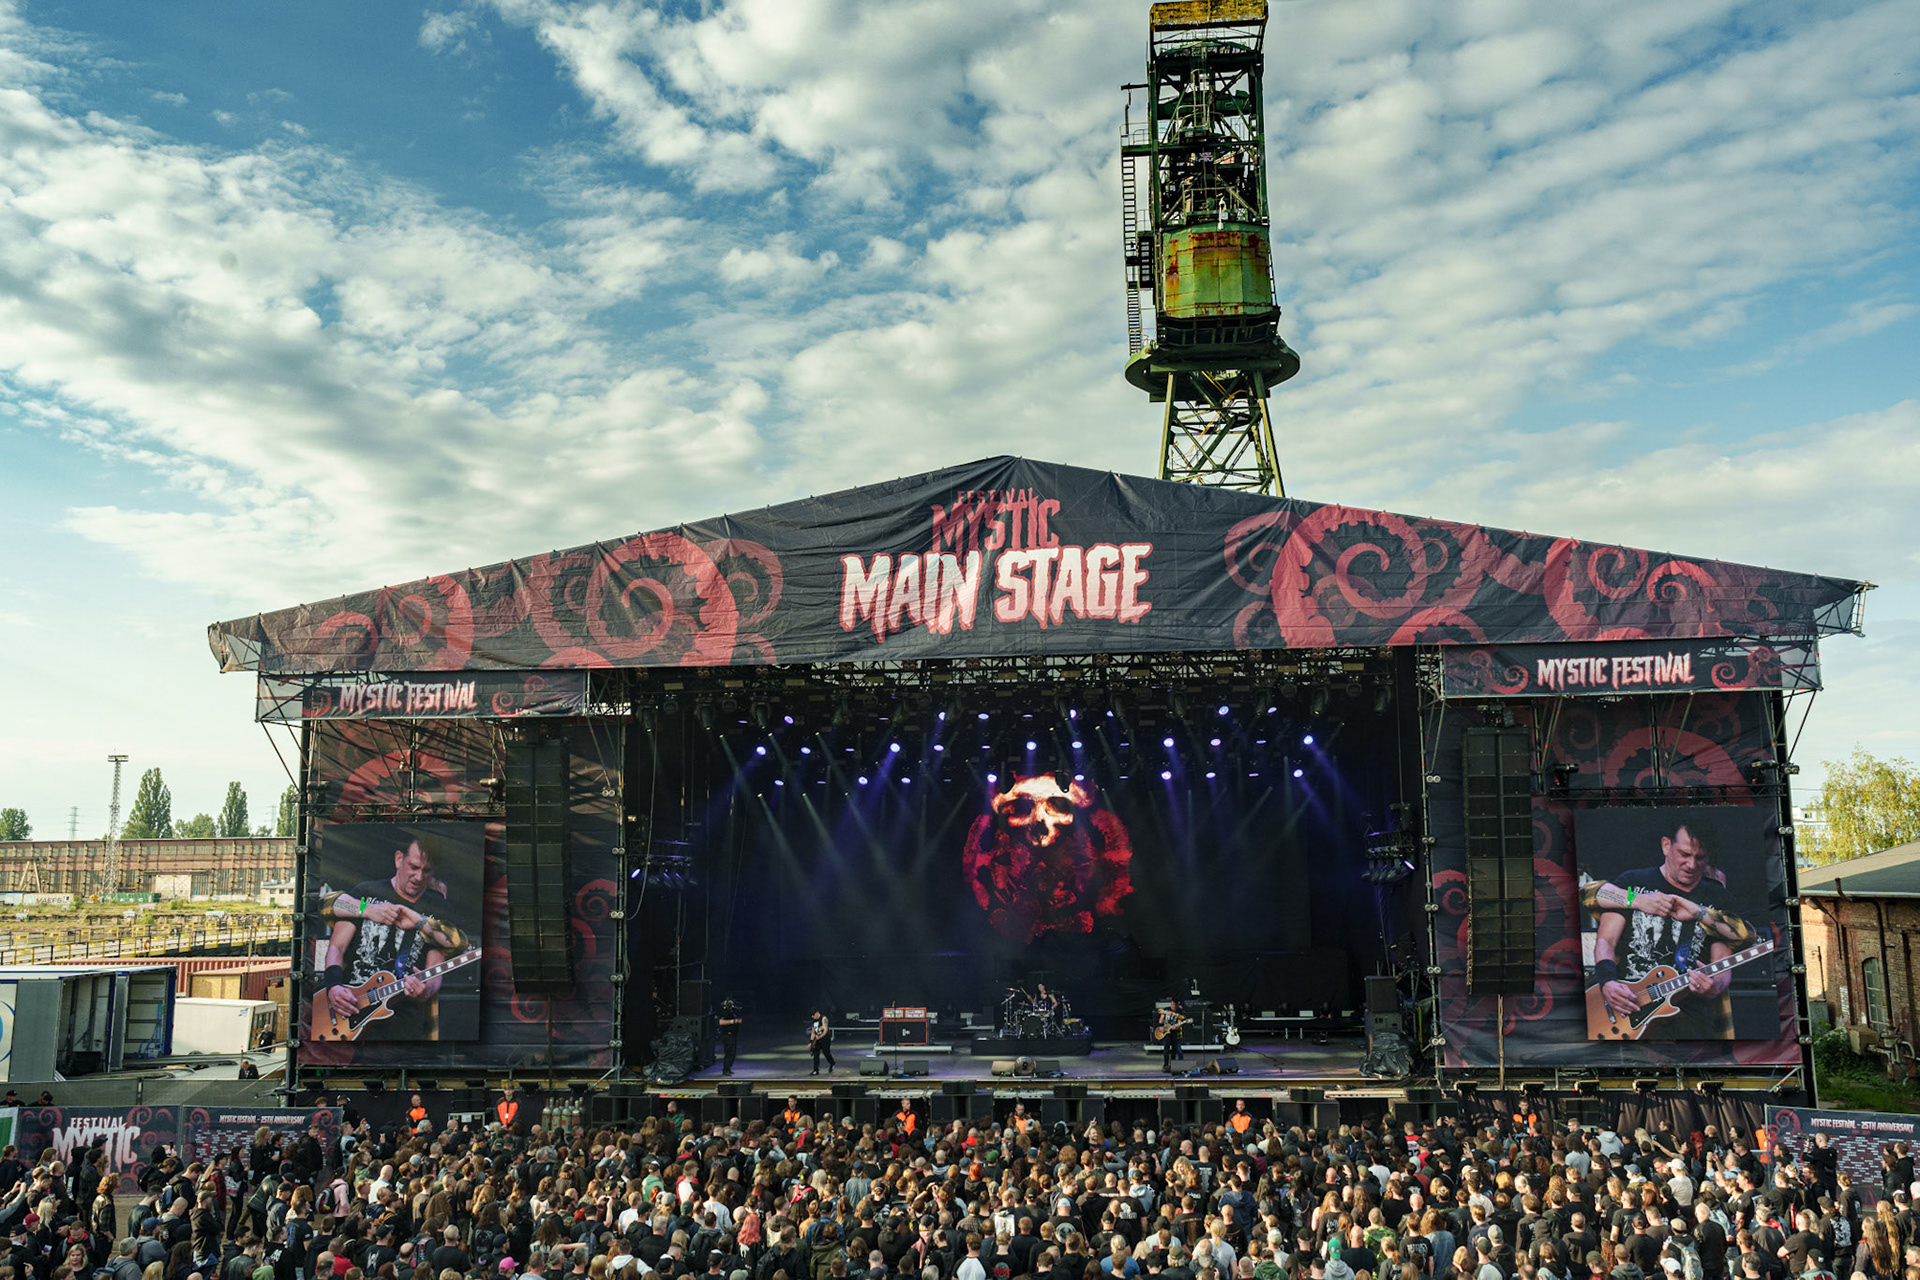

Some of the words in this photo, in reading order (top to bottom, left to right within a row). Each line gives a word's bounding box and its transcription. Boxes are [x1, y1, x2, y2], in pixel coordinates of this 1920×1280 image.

[957, 487, 1040, 506] FESTIVAL
[931, 500, 1061, 553] MYSTIC
[840, 550, 982, 643] MAIN
[994, 543, 1153, 629] STAGE
[1536, 657, 1608, 691] MYSTIC
[1611, 652, 1695, 690] FESTIVAL
[340, 682, 404, 715] MYSTIC
[405, 679, 478, 715] FESTIVAL
[71, 1116, 127, 1129] FESTIVAL
[1811, 1118, 1832, 1127] MYSTIC
[1833, 1119, 1855, 1129] FESTIVAL
[1861, 1121, 1876, 1131] 25TH
[1877, 1122, 1914, 1133] ANNIVERSARY
